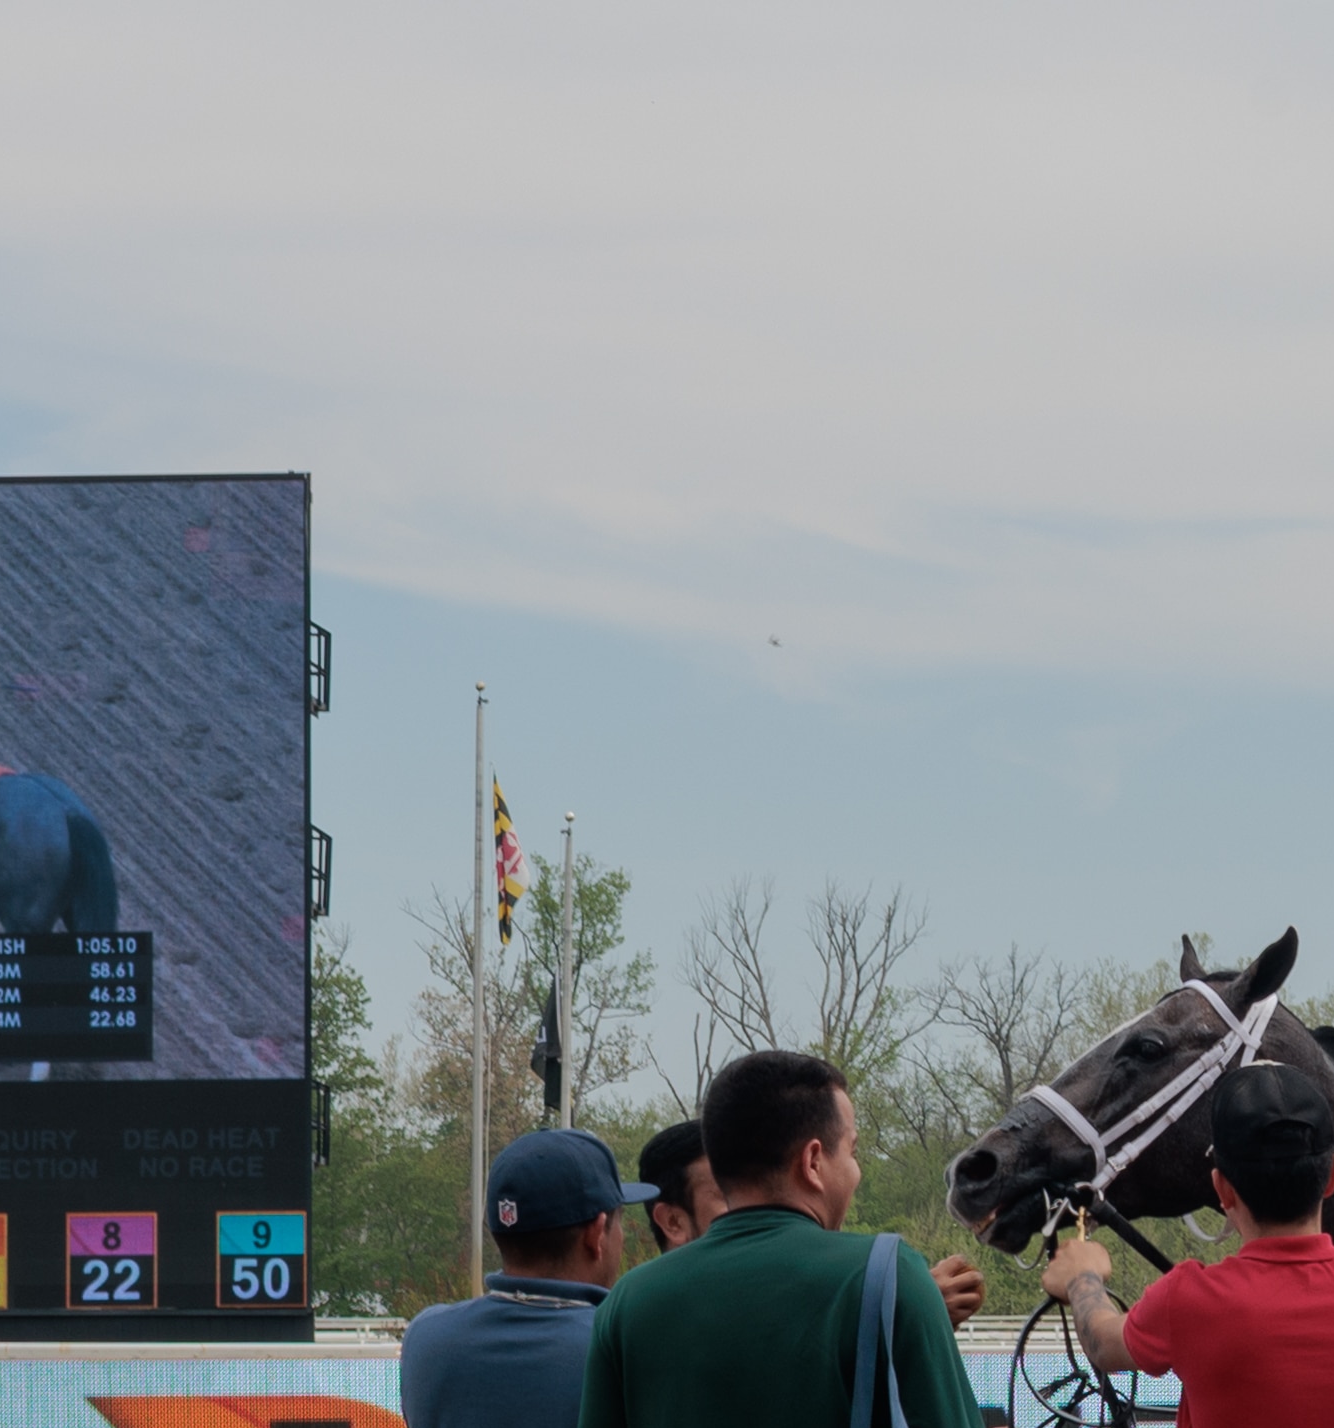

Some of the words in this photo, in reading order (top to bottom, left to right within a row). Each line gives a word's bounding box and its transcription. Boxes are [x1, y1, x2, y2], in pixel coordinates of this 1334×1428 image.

[75, 937, 137, 954] 1:05.10
[90, 962, 135, 978] 58.61
[89, 986, 137, 1003] 46.23
[89, 1010, 137, 1028] 22.68
[102, 1221, 122, 1251] 8
[251, 1219, 271, 1250] 9
[82, 1259, 142, 1301] 22
[231, 1258, 291, 1300] 50
